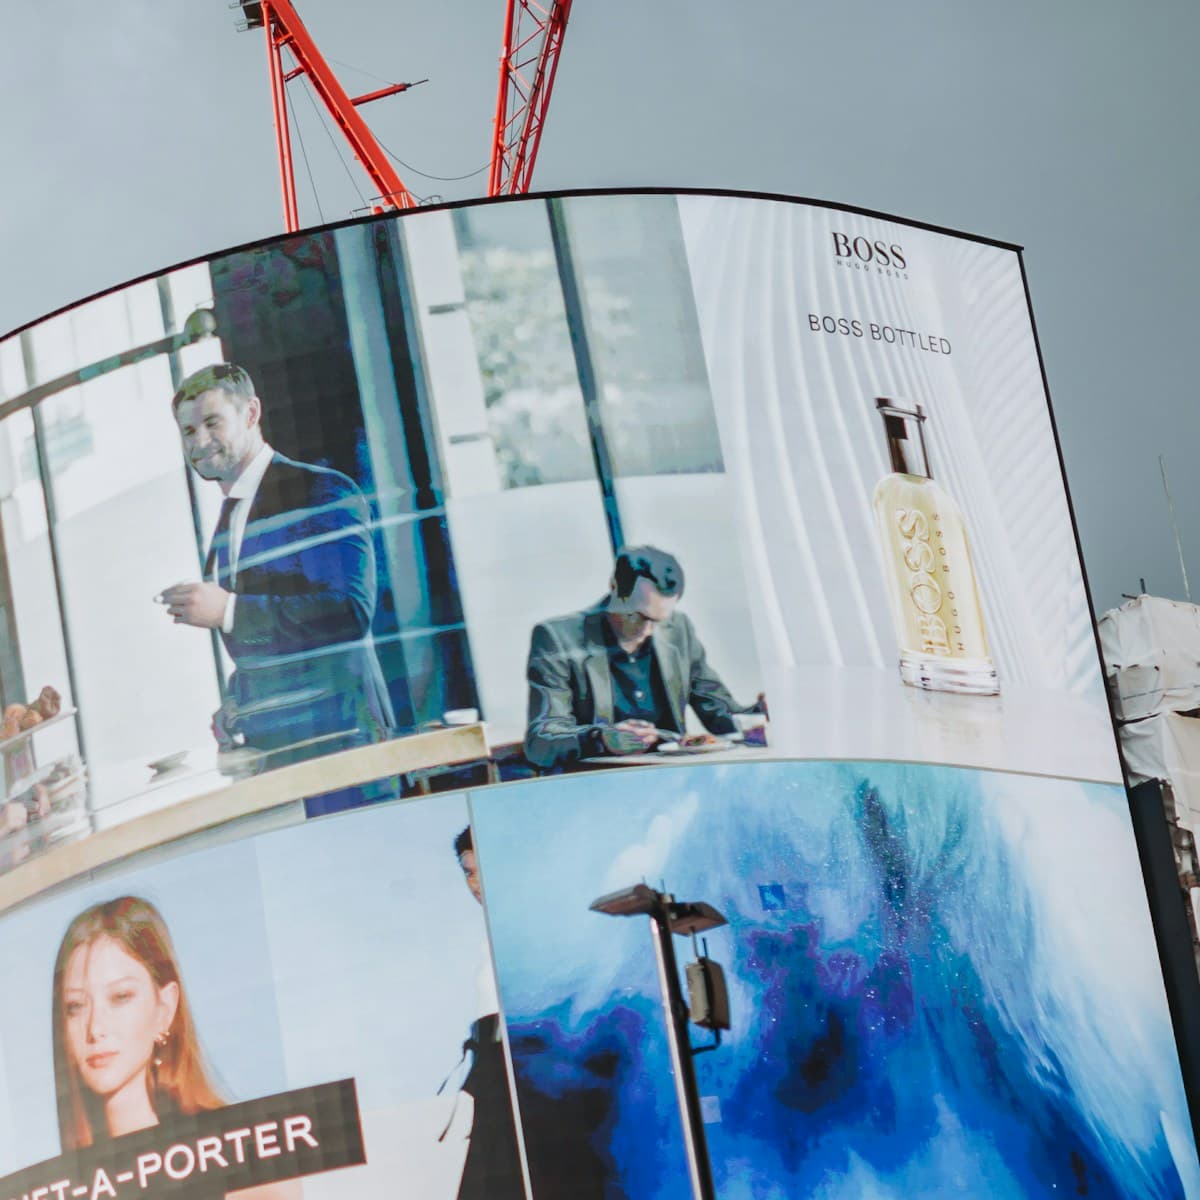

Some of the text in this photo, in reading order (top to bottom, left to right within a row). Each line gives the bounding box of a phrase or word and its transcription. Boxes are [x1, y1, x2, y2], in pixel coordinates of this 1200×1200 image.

[832, 232, 907, 270] BOSS
[808, 313, 952, 355] BOSS BOTTLED
